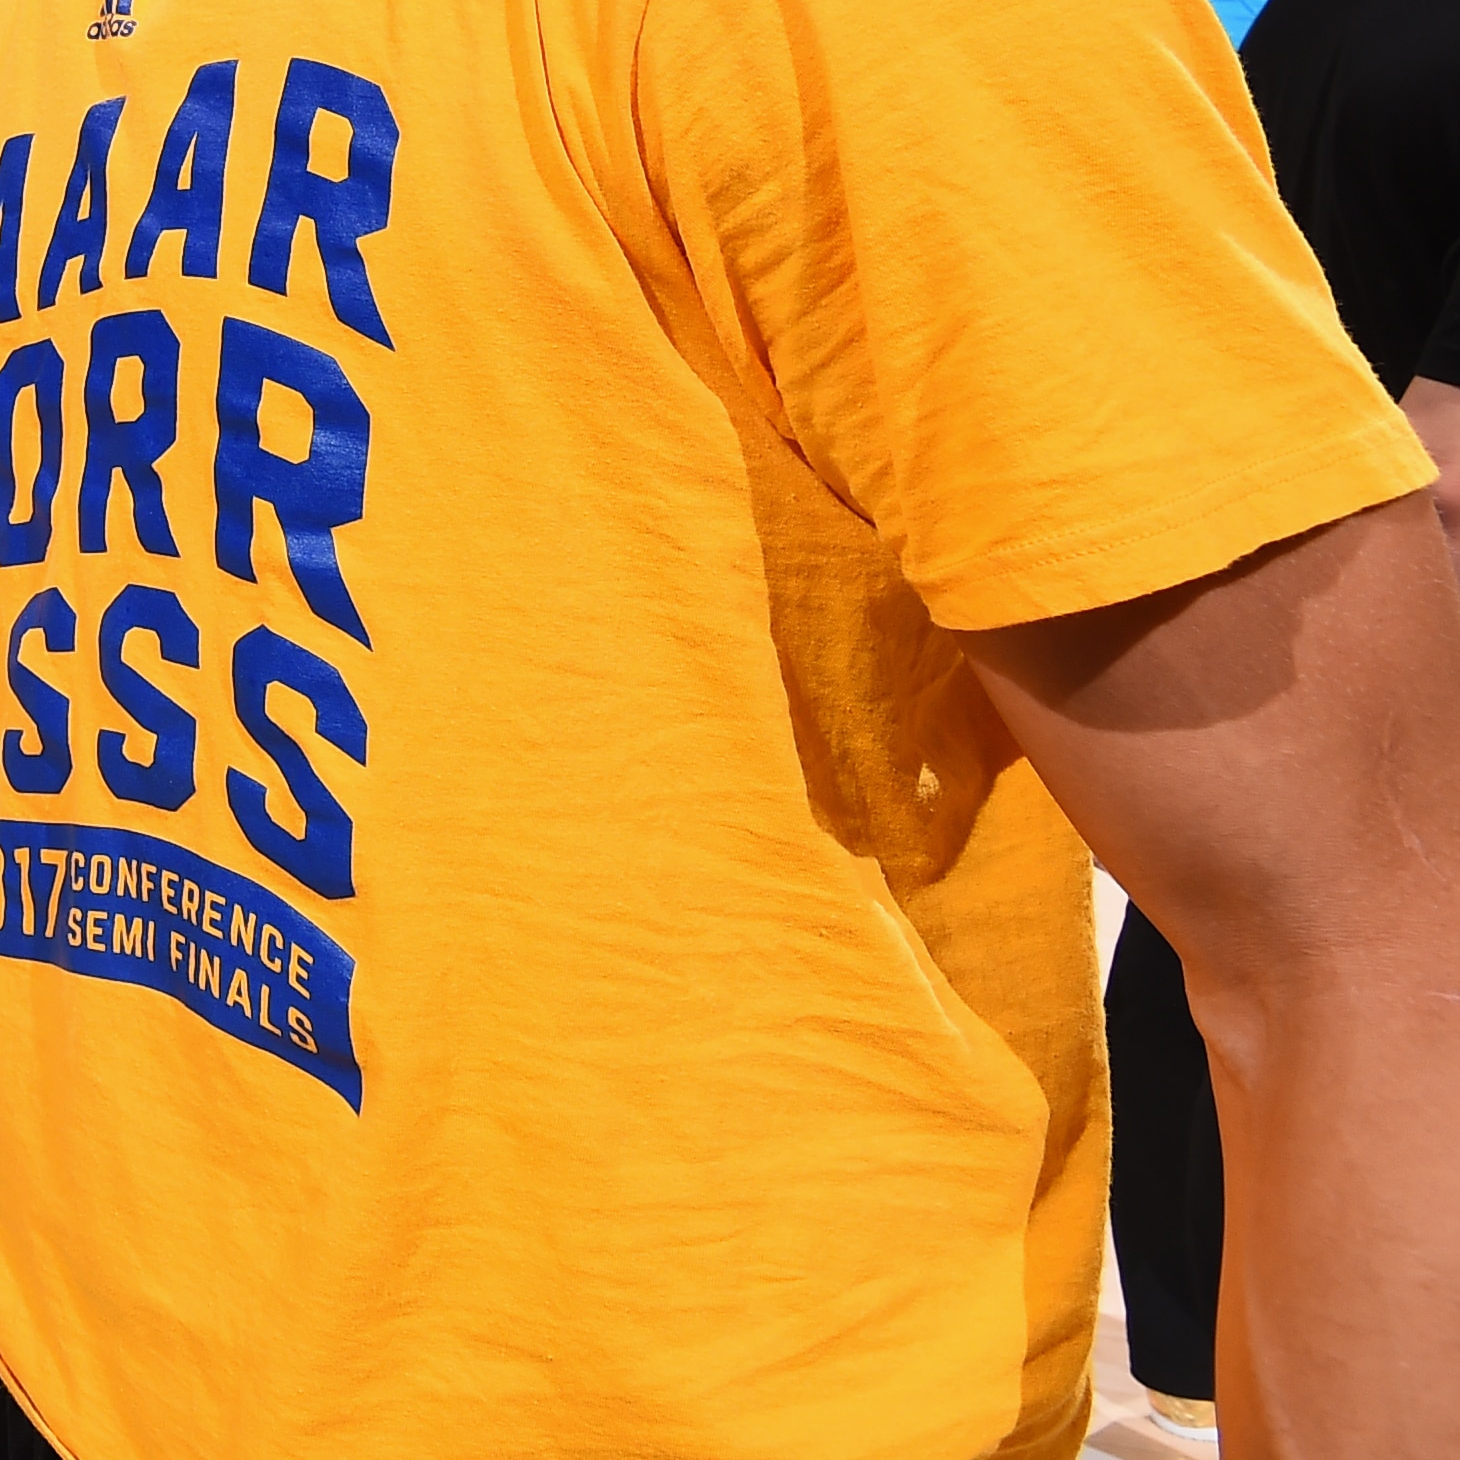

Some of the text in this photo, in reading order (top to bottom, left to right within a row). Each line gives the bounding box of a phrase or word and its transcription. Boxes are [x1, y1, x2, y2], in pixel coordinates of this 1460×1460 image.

[67, 907, 319, 1056] SEMI FINALS
[71, 851, 317, 1000] CONFERENCE
